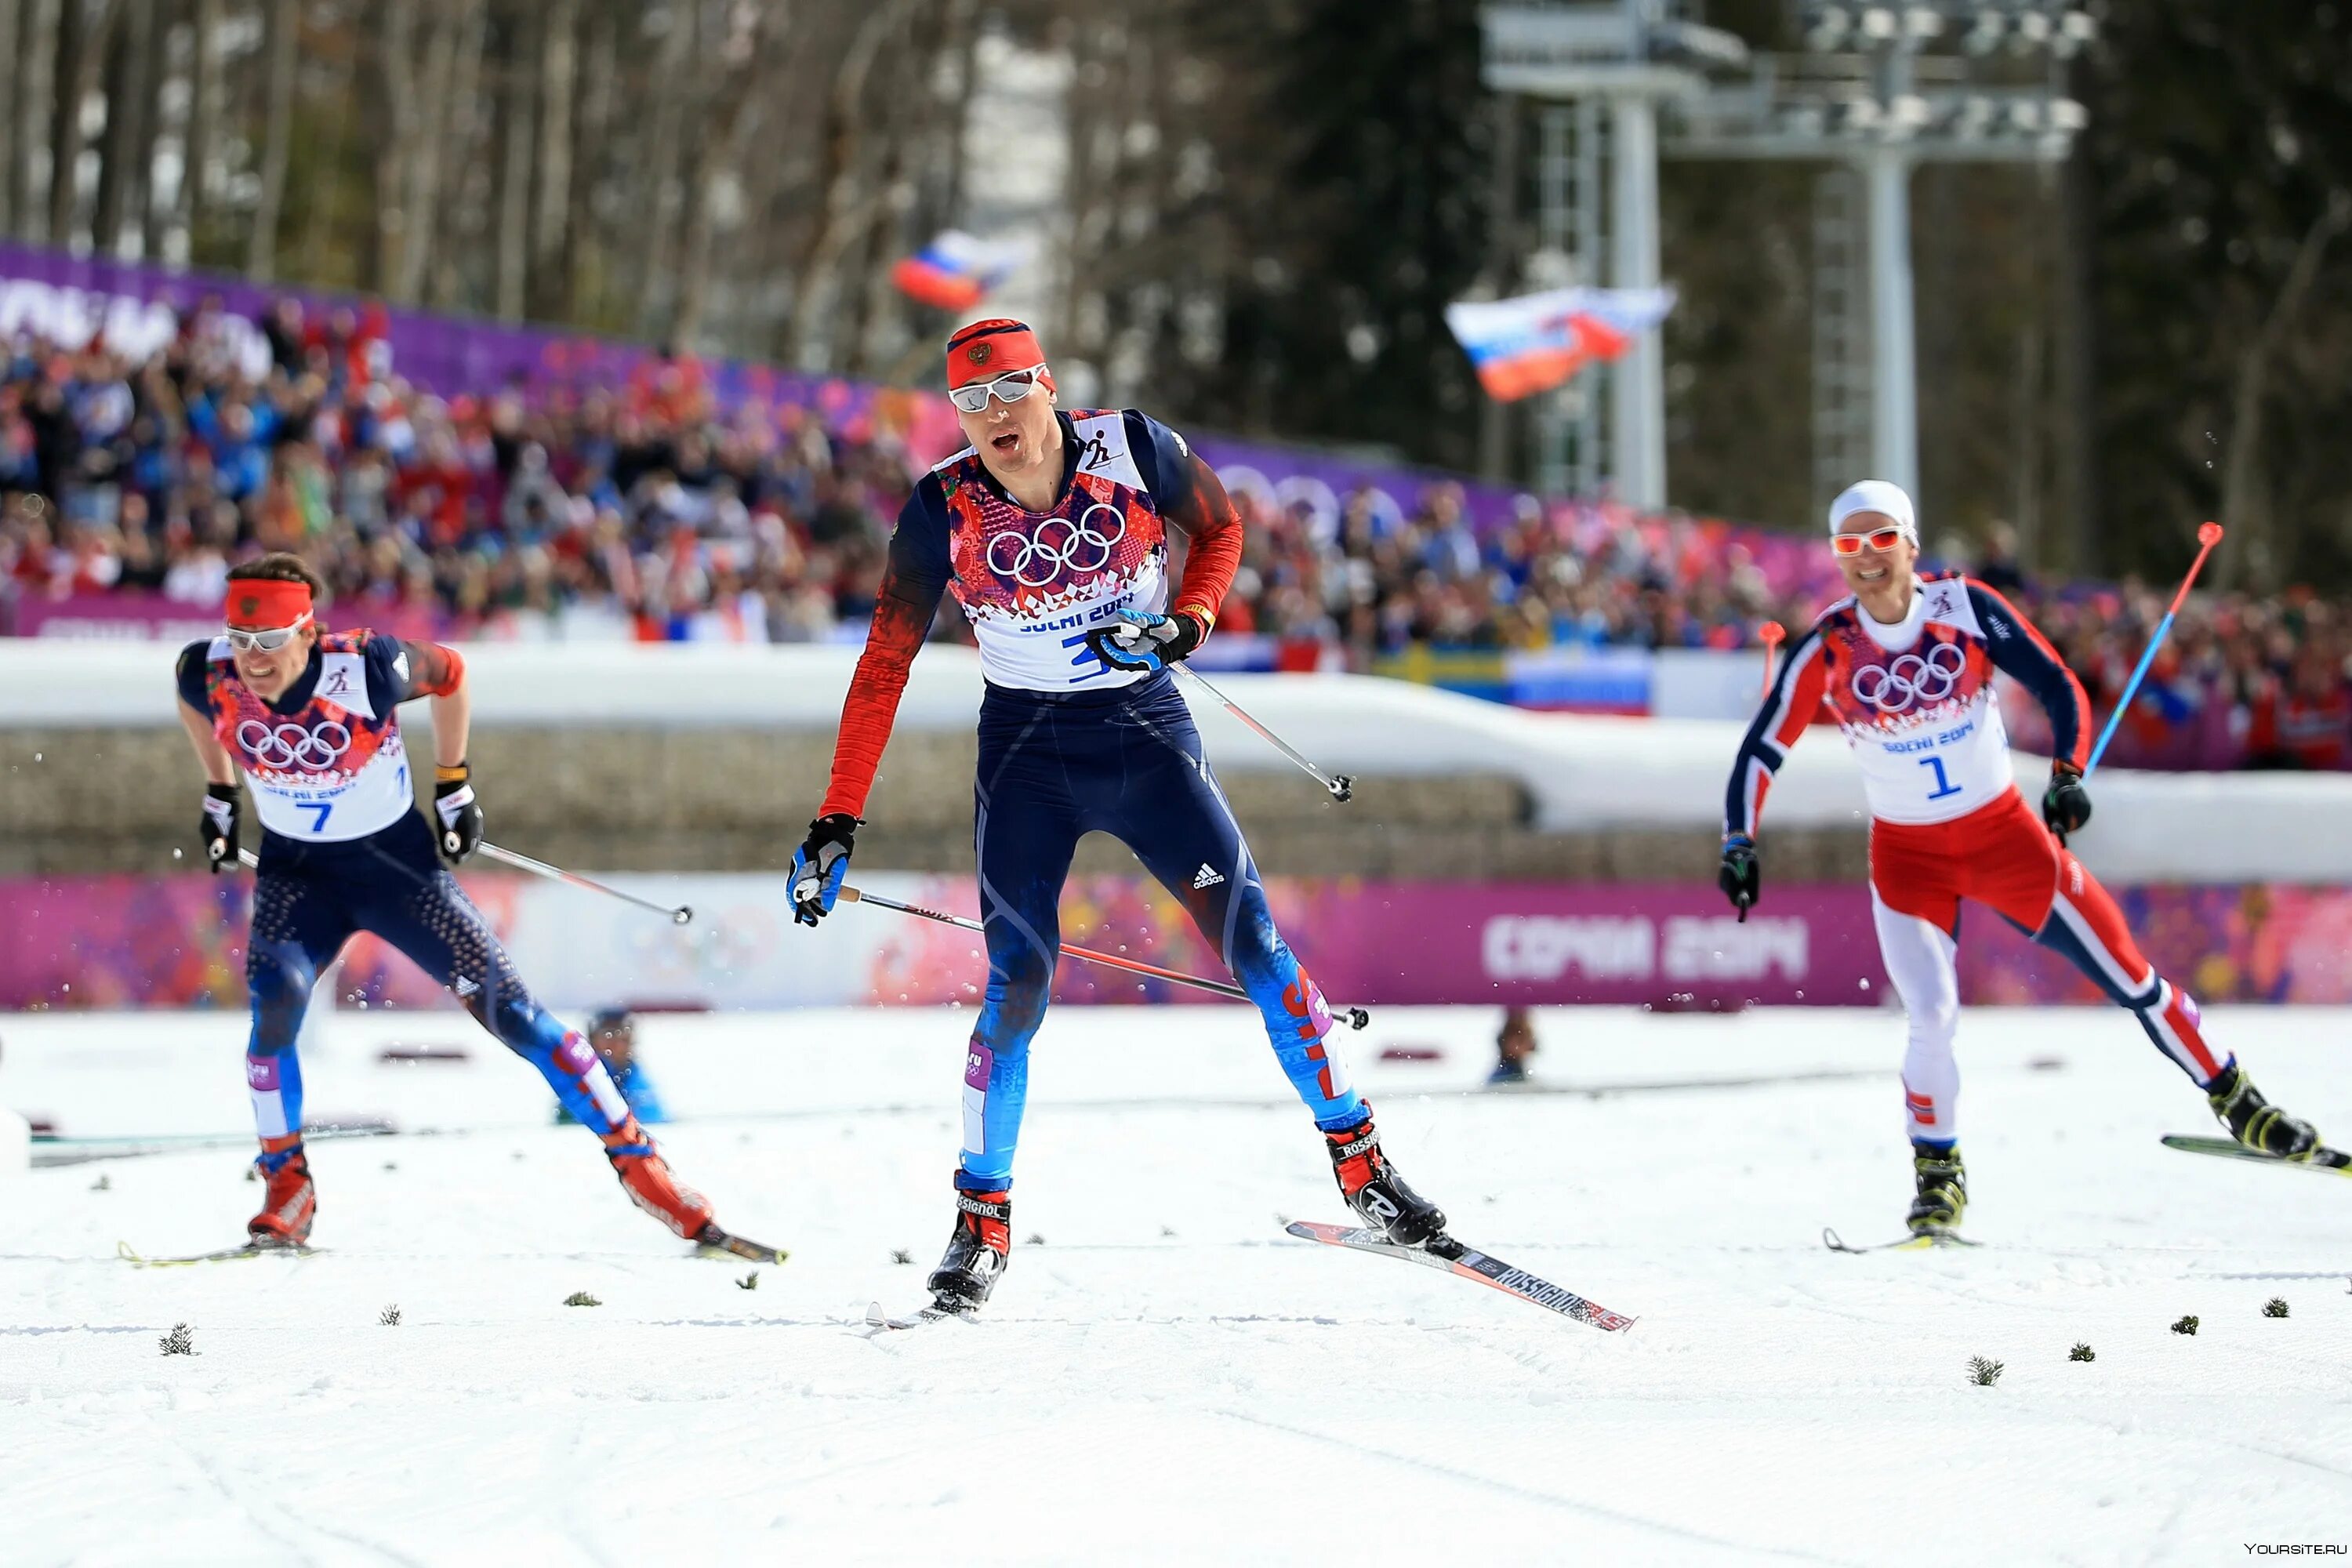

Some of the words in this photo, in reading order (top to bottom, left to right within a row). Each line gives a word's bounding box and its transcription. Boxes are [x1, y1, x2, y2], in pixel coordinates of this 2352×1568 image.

[1919, 757, 1962, 799] 1
[296, 802, 332, 832] 7
[1193, 874, 1225, 890] adidas
